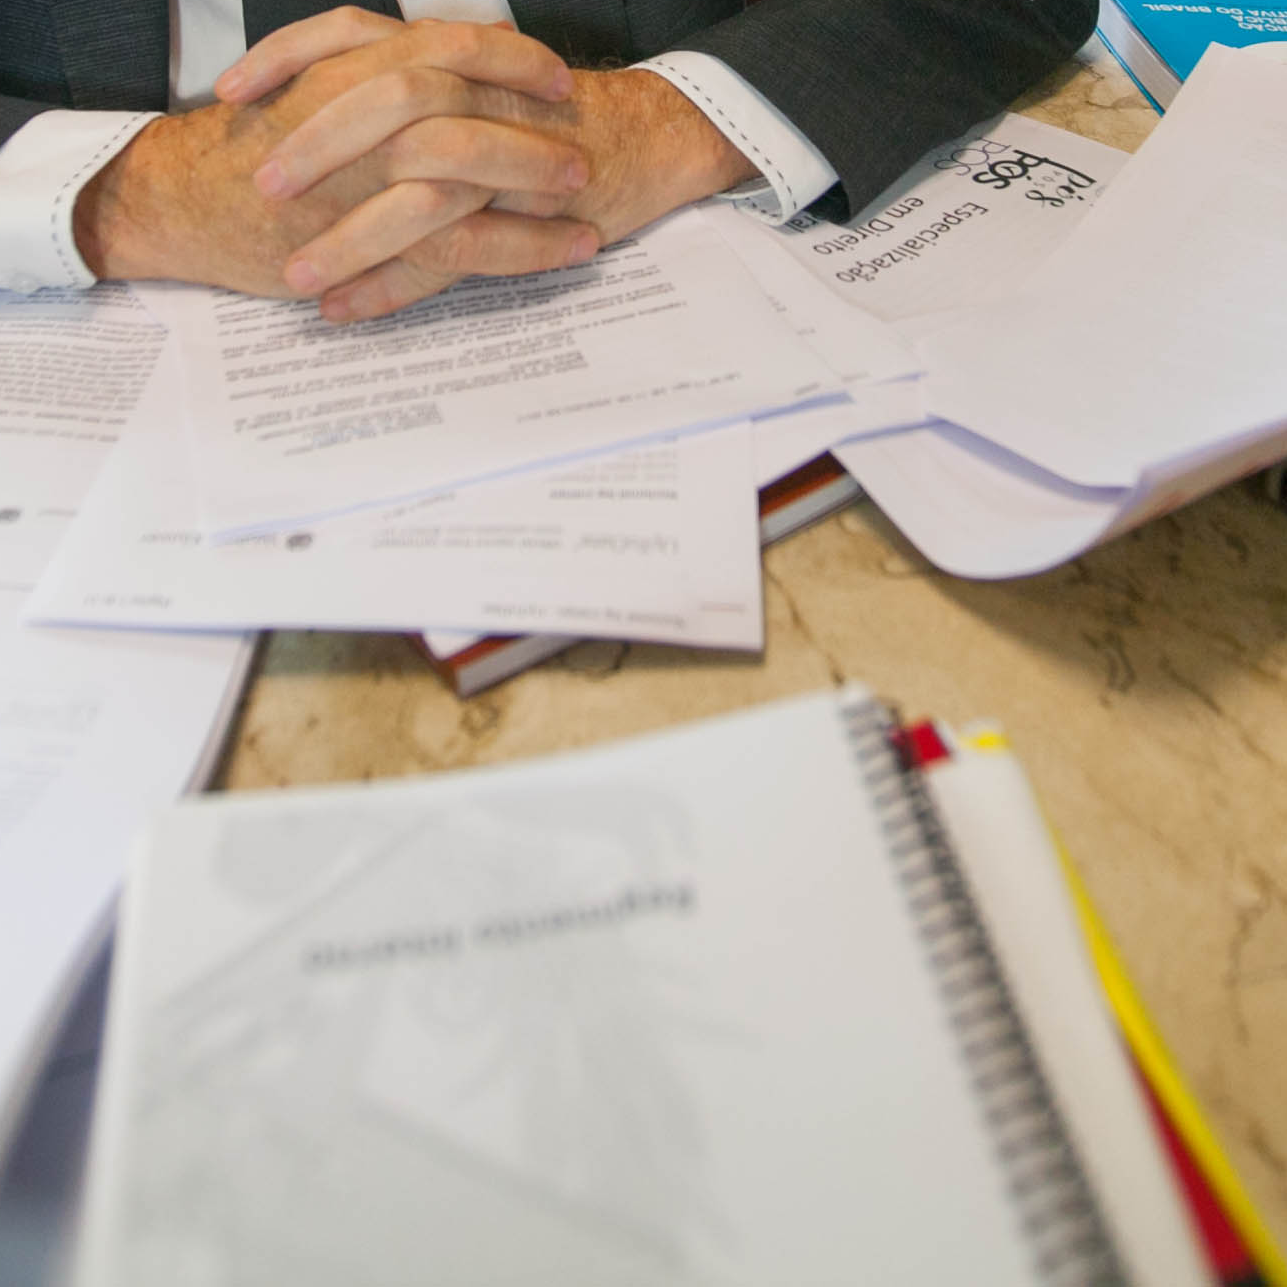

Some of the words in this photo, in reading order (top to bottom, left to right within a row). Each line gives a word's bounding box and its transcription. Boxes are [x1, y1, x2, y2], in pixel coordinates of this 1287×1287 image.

[1142, 3, 1212, 14] BRASIL
[1215, 6, 1245, 16] DO
[885, 196, 924, 223] em
[813, 217, 895, 256] Direito
[835, 201, 990, 284] Especialização
